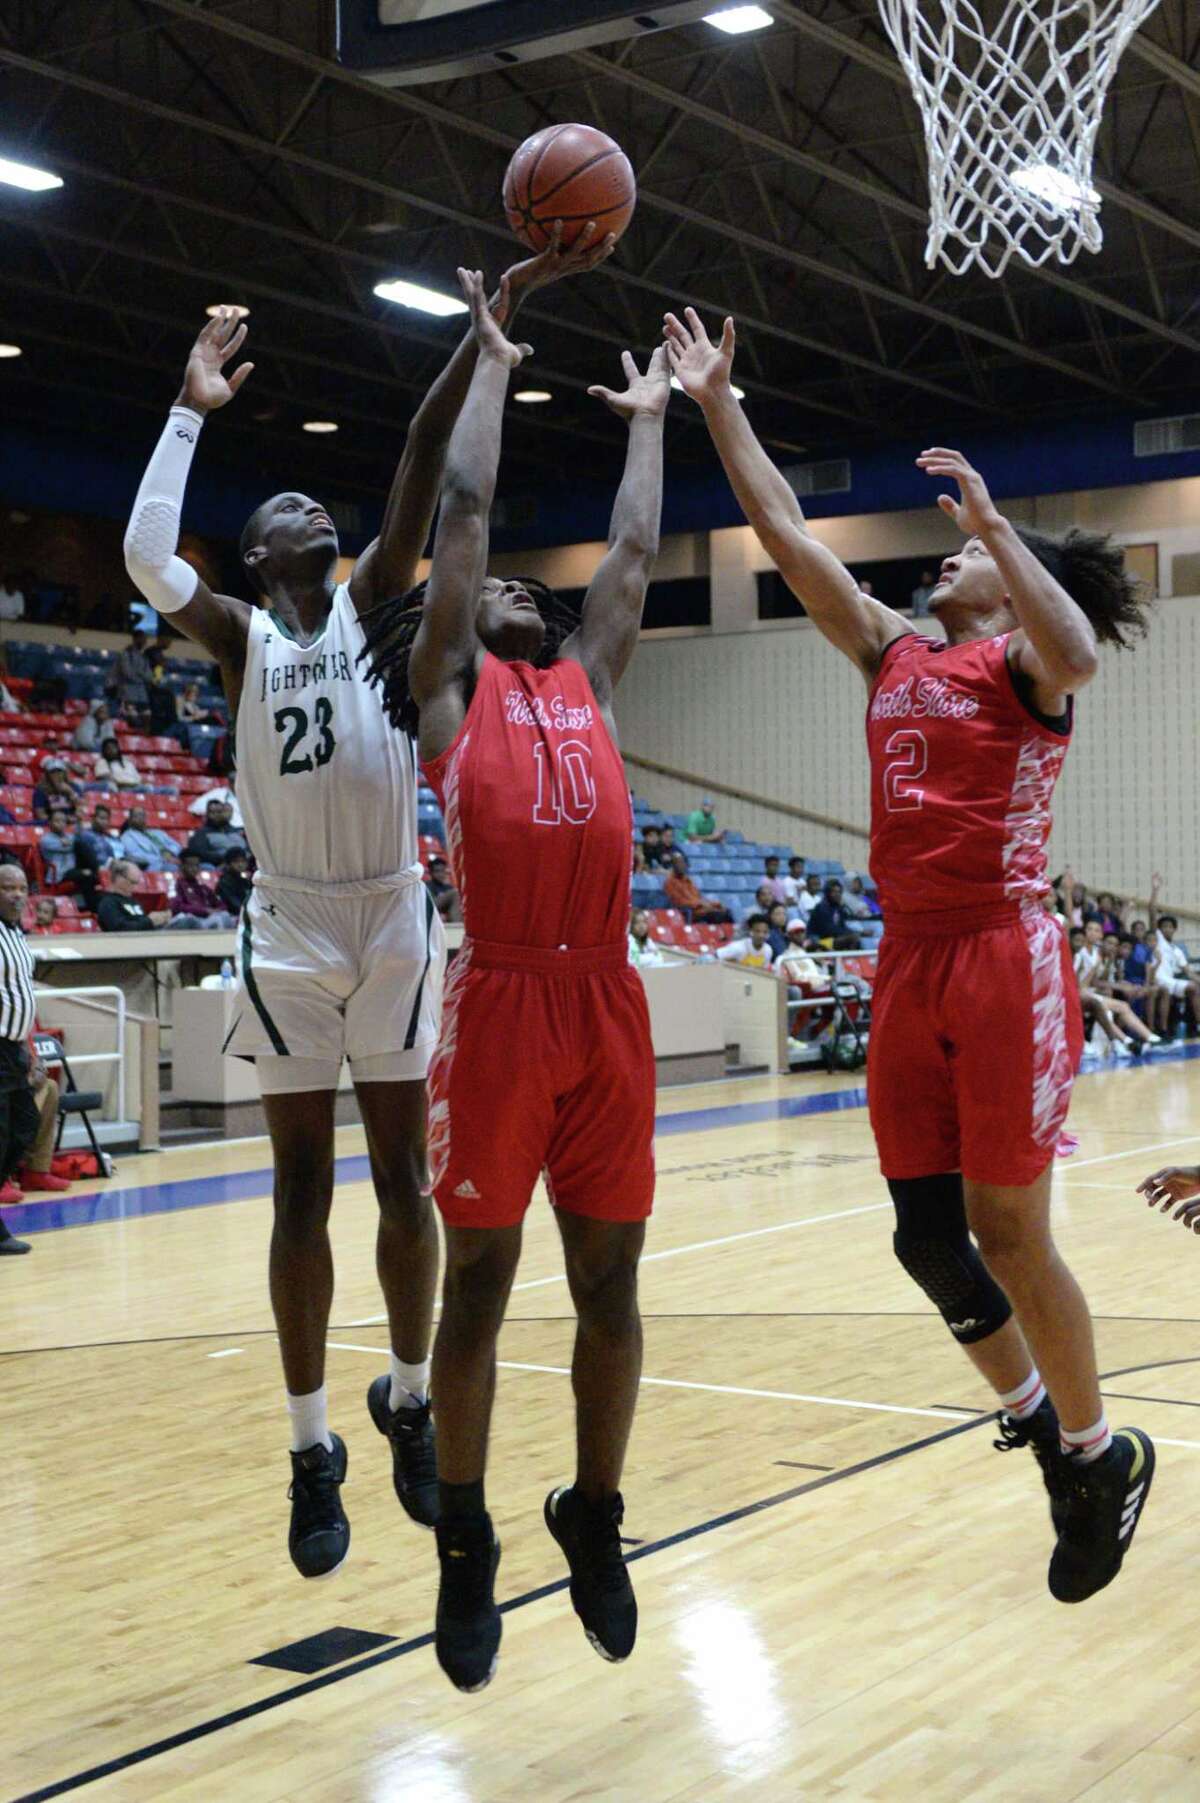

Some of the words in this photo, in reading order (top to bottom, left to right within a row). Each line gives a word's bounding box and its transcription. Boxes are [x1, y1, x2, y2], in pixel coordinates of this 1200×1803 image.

[274, 697, 336, 776] 23
[883, 729, 928, 812] 2
[533, 739, 596, 825] 10
